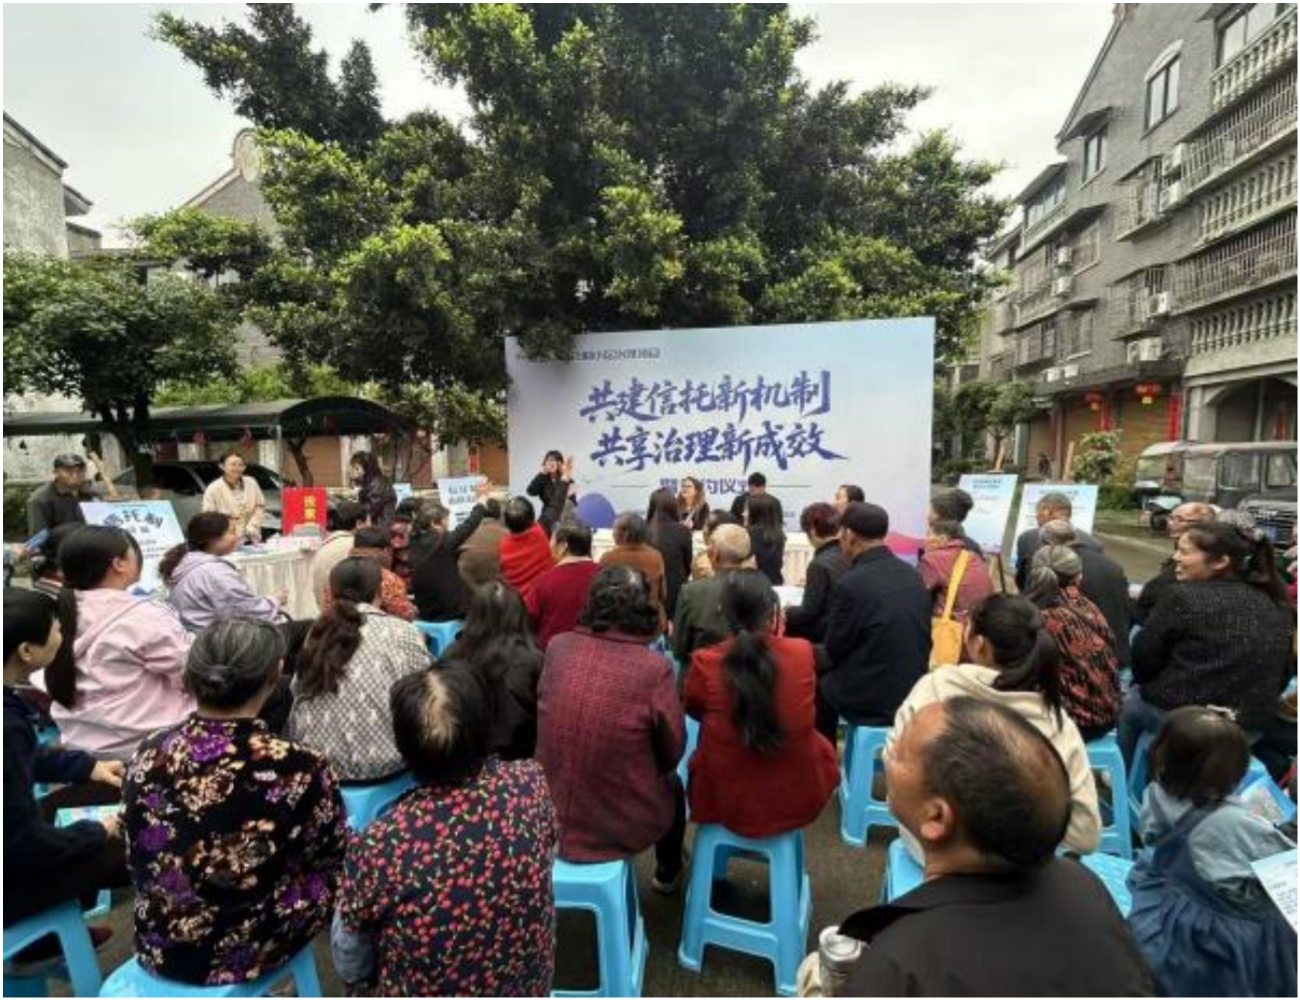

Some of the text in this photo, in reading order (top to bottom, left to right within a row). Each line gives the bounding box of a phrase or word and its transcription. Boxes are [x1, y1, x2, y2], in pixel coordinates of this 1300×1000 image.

[579, 370, 832, 424] 共建信托新机制
[589, 419, 850, 474] 共享治理新成效
